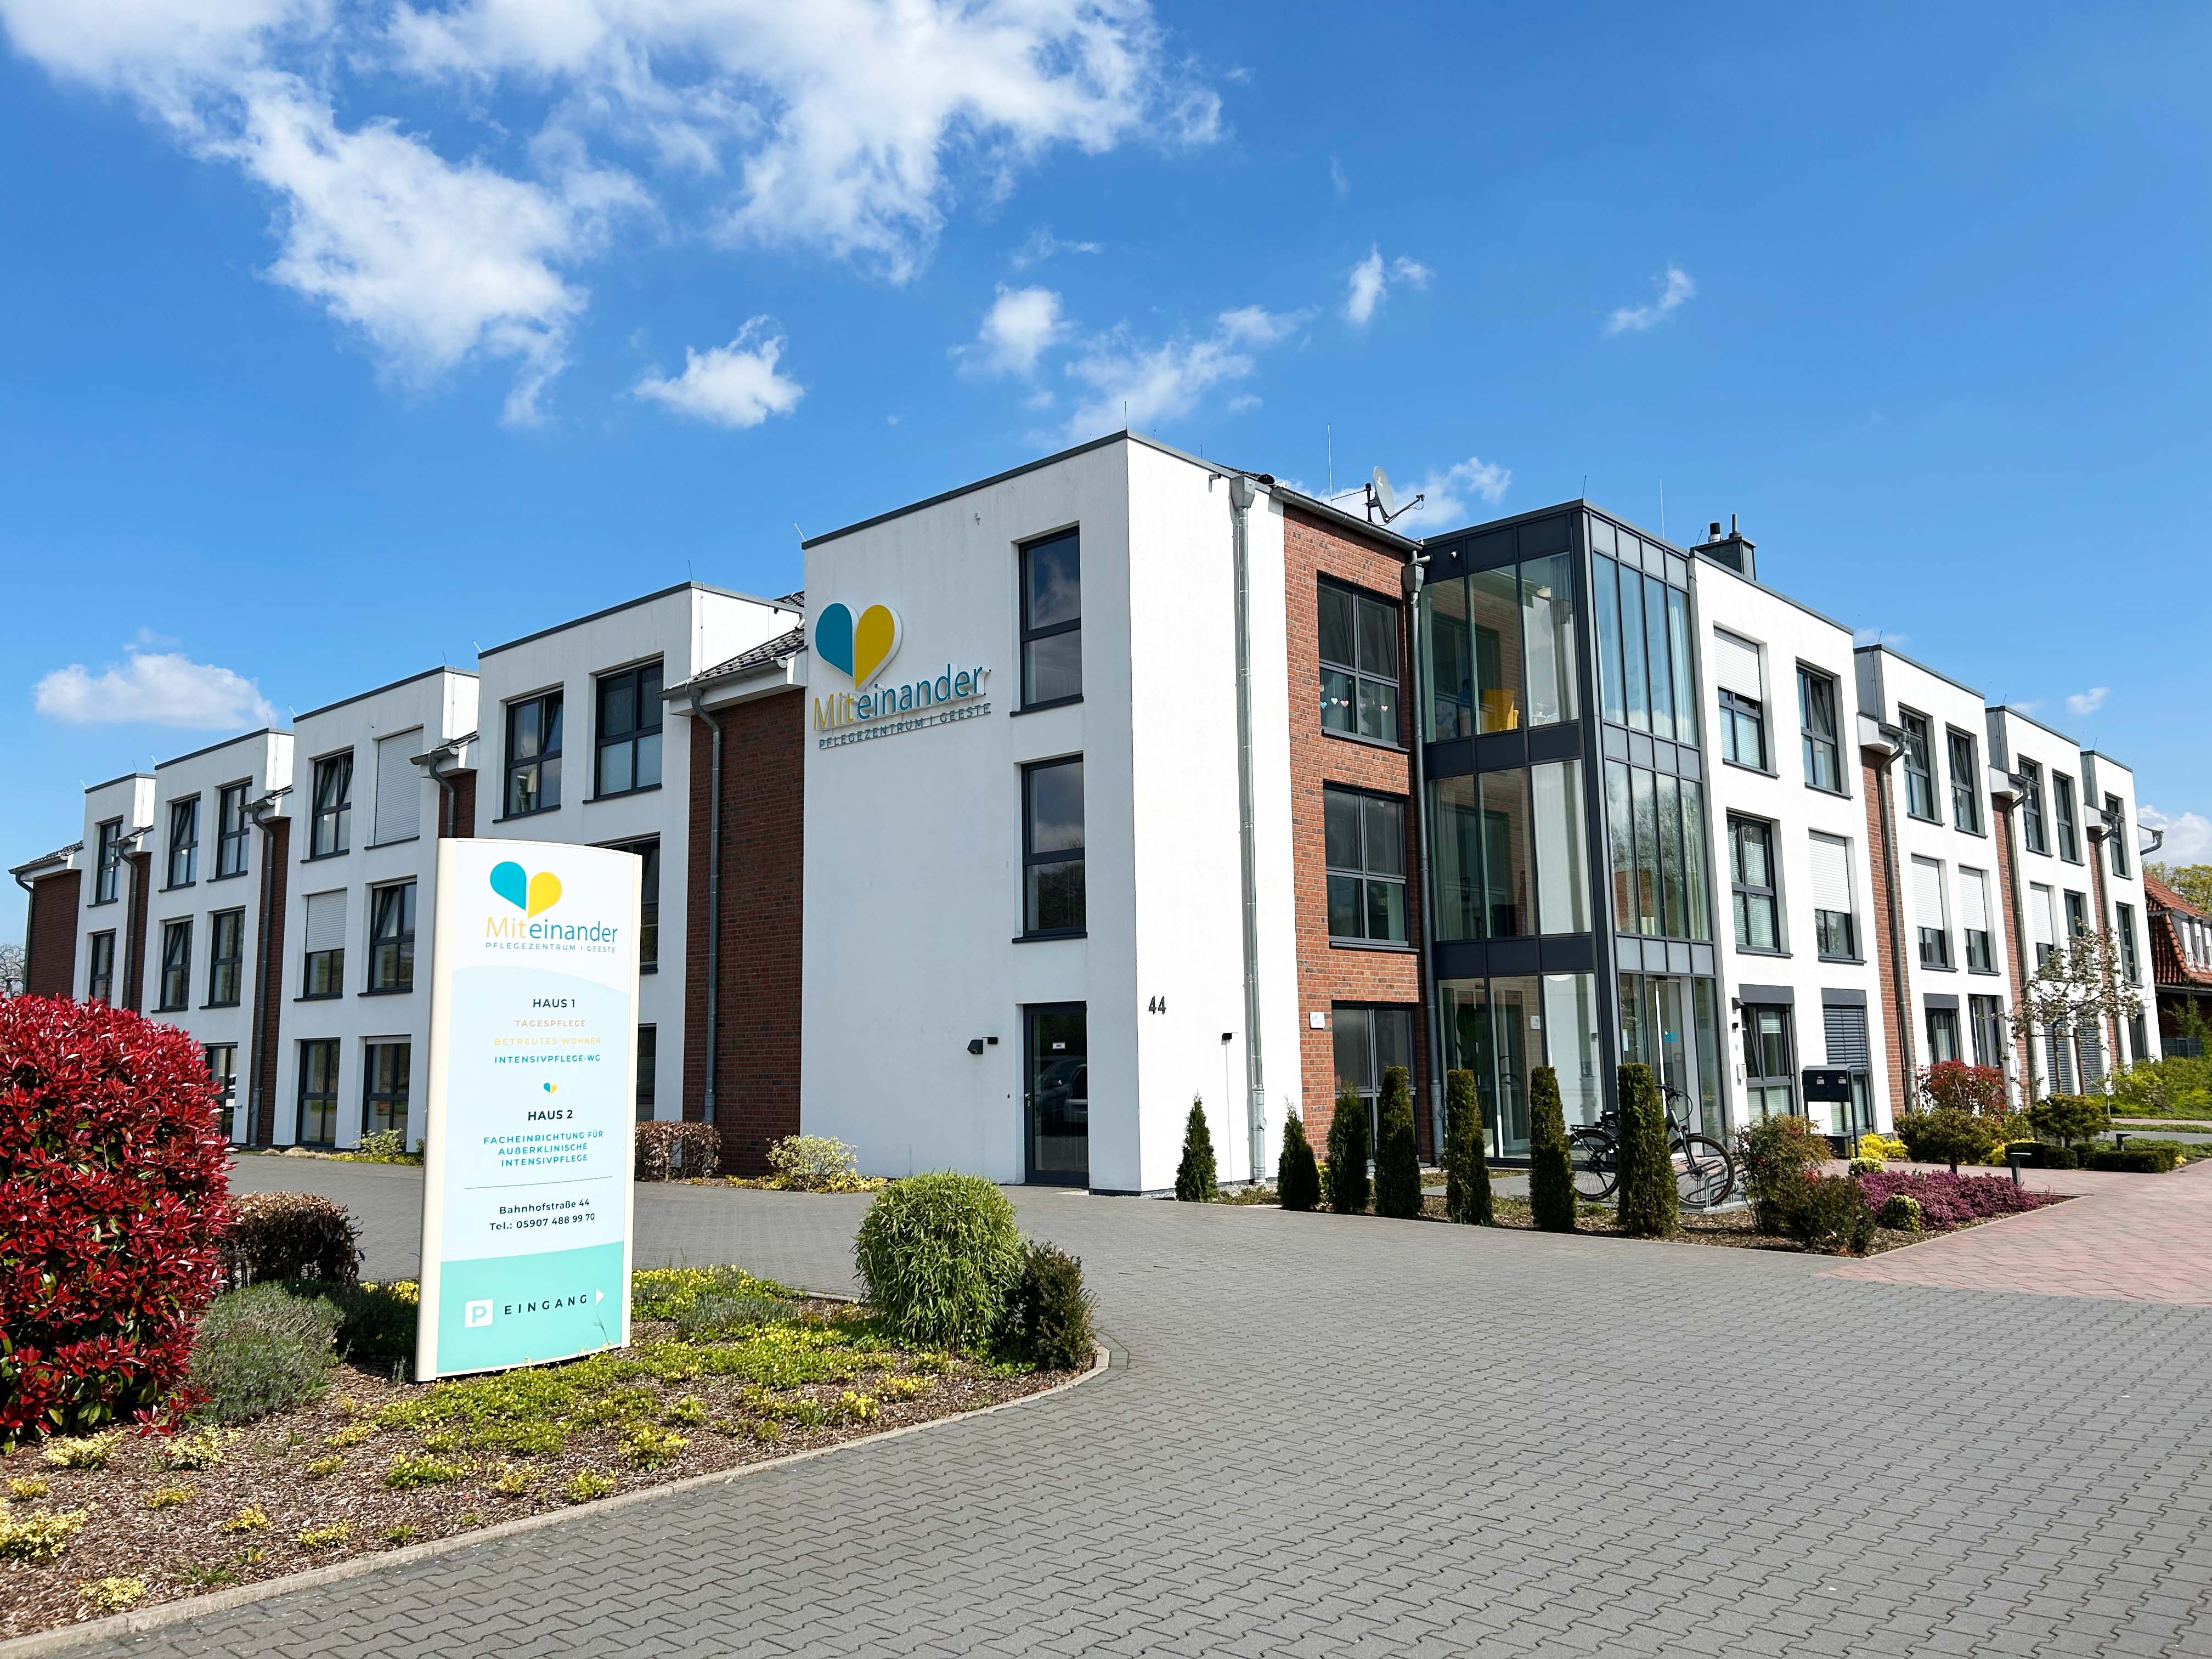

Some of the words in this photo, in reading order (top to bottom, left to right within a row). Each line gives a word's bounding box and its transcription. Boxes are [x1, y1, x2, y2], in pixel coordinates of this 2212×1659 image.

[814, 663, 983, 730] Miteinander
[819, 718, 923, 749] PFLEGEZENTRUM
[940, 703, 991, 723] GEESTE
[486, 917, 618, 943] Miteinander
[486, 942, 576, 951] PFLEGEZENTRUM
[533, 998, 567, 1008] HAUS
[571, 999, 575, 1008] 1
[1148, 995, 1166, 1015] 44
[515, 1019, 586, 1028] TAGESPFLEGE
[494, 1037, 558, 1046] BETREUTES
[562, 1036, 601, 1045] WOHNEN
[494, 1054, 601, 1064] INTENSIVPFLEGE-WG
[528, 1110, 563, 1121] HAUS
[567, 1109, 573, 1119] 2
[483, 1131, 585, 1145] FACHEINRICHTUNG
[588, 1130, 604, 1138] FÜR
[501, 1154, 588, 1167] INTENSIVPFLEGE
[499, 1200, 577, 1215] Bahnhofstraße
[579, 1198, 590, 1207] 44
[489, 1222, 514, 1231] Tel.:
[516, 1217, 549, 1229] 05907
[551, 1216, 570, 1226] 488
[572, 1214, 584, 1223] 99
[585, 1213, 595, 1222] 70
[471, 1306, 487, 1324] P
[504, 1294, 588, 1315] EINGANG
